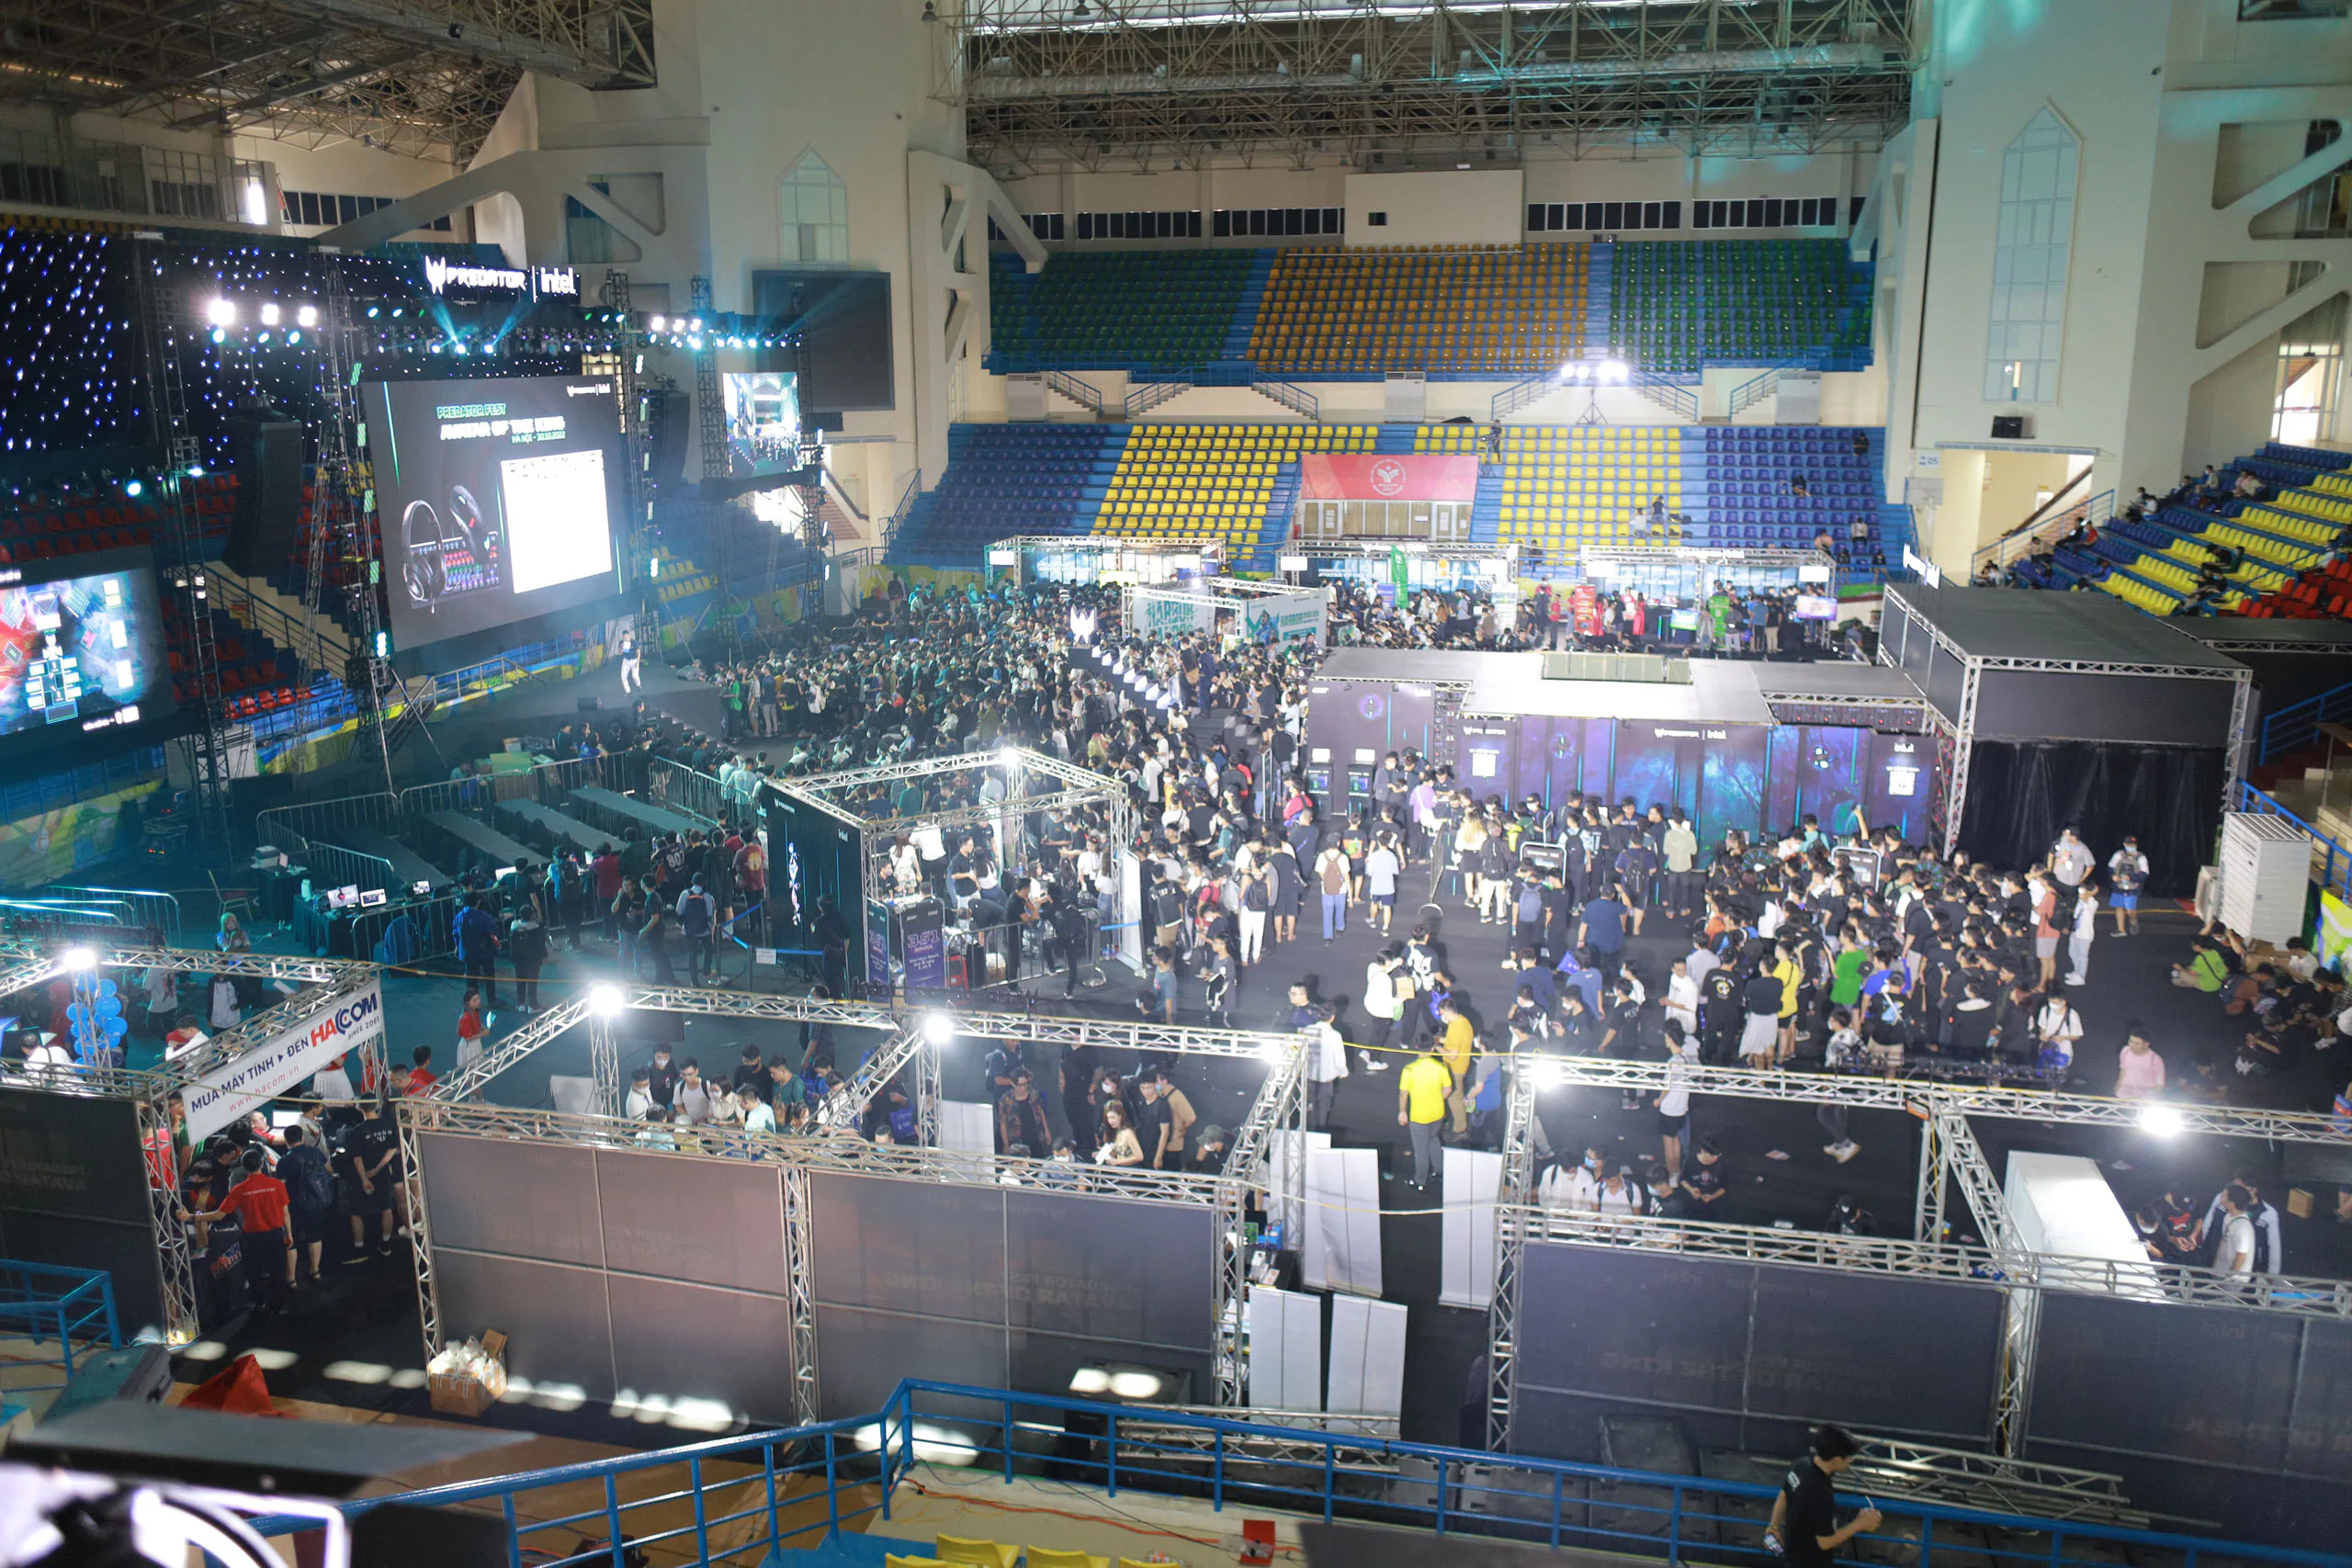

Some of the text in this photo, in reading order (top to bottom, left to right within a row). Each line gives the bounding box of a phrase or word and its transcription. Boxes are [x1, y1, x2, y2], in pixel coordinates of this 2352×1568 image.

[447, 267, 526, 291] PREDATOR
[437, 403, 506, 419] PREDATOR FEST
[509, 418, 535, 434] THE
[191, 1089, 220, 1112] MUA
[220, 1072, 245, 1096] MÁY
[246, 1055, 275, 1080] TÍNH
[311, 992, 378, 1047] HACOM
[229, 1065, 300, 1112] www.hacom.vn
